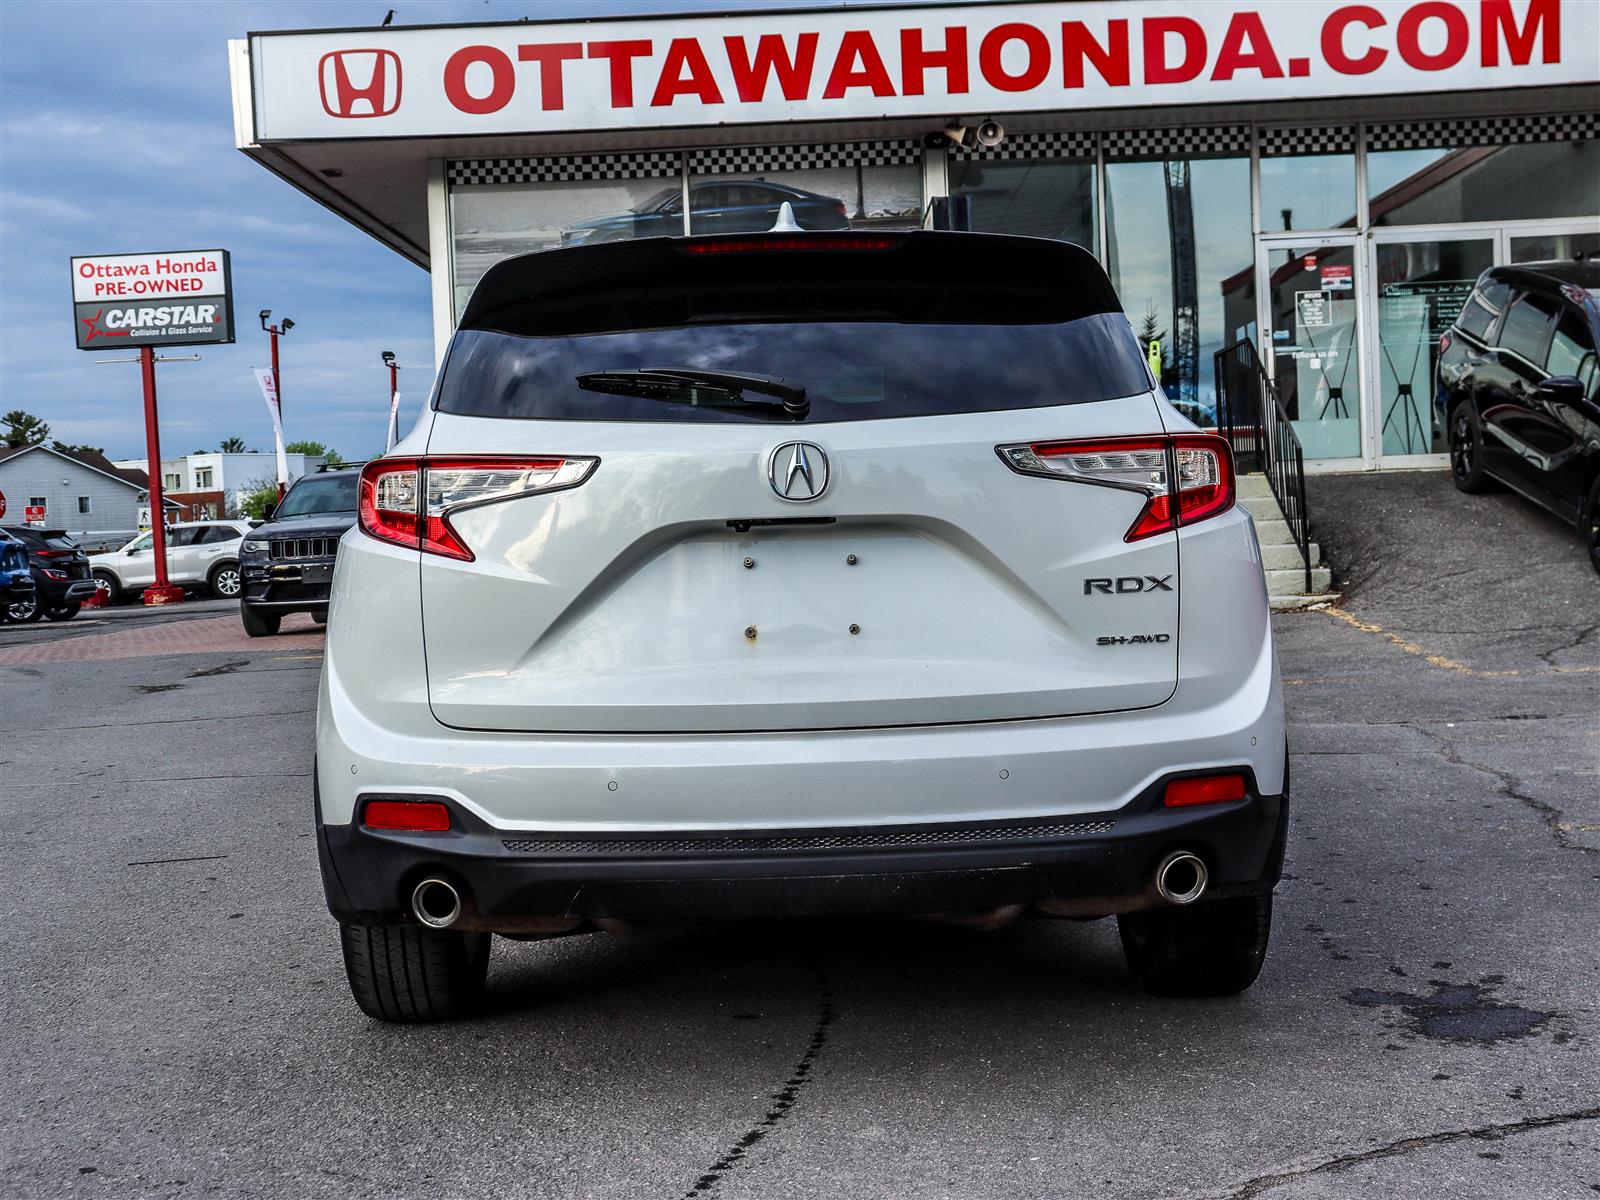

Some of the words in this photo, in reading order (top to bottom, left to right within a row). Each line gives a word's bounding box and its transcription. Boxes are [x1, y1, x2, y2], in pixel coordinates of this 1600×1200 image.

[443, 0, 1560, 115] OTTAWAHONDA.COM
[79, 262, 150, 279] Ottawa
[156, 257, 218, 275] Honda
[95, 278, 203, 296] PRE-OWNED
[105, 304, 215, 329] CARSTAR
[130, 329, 160, 337] Collision
[168, 327, 187, 335] Glass
[188, 325, 213, 334] Service
[25, 513, 45, 521] PASSING
[1083, 574, 1173, 595] RDX
[1096, 634, 1170, 646] SH-AWD
